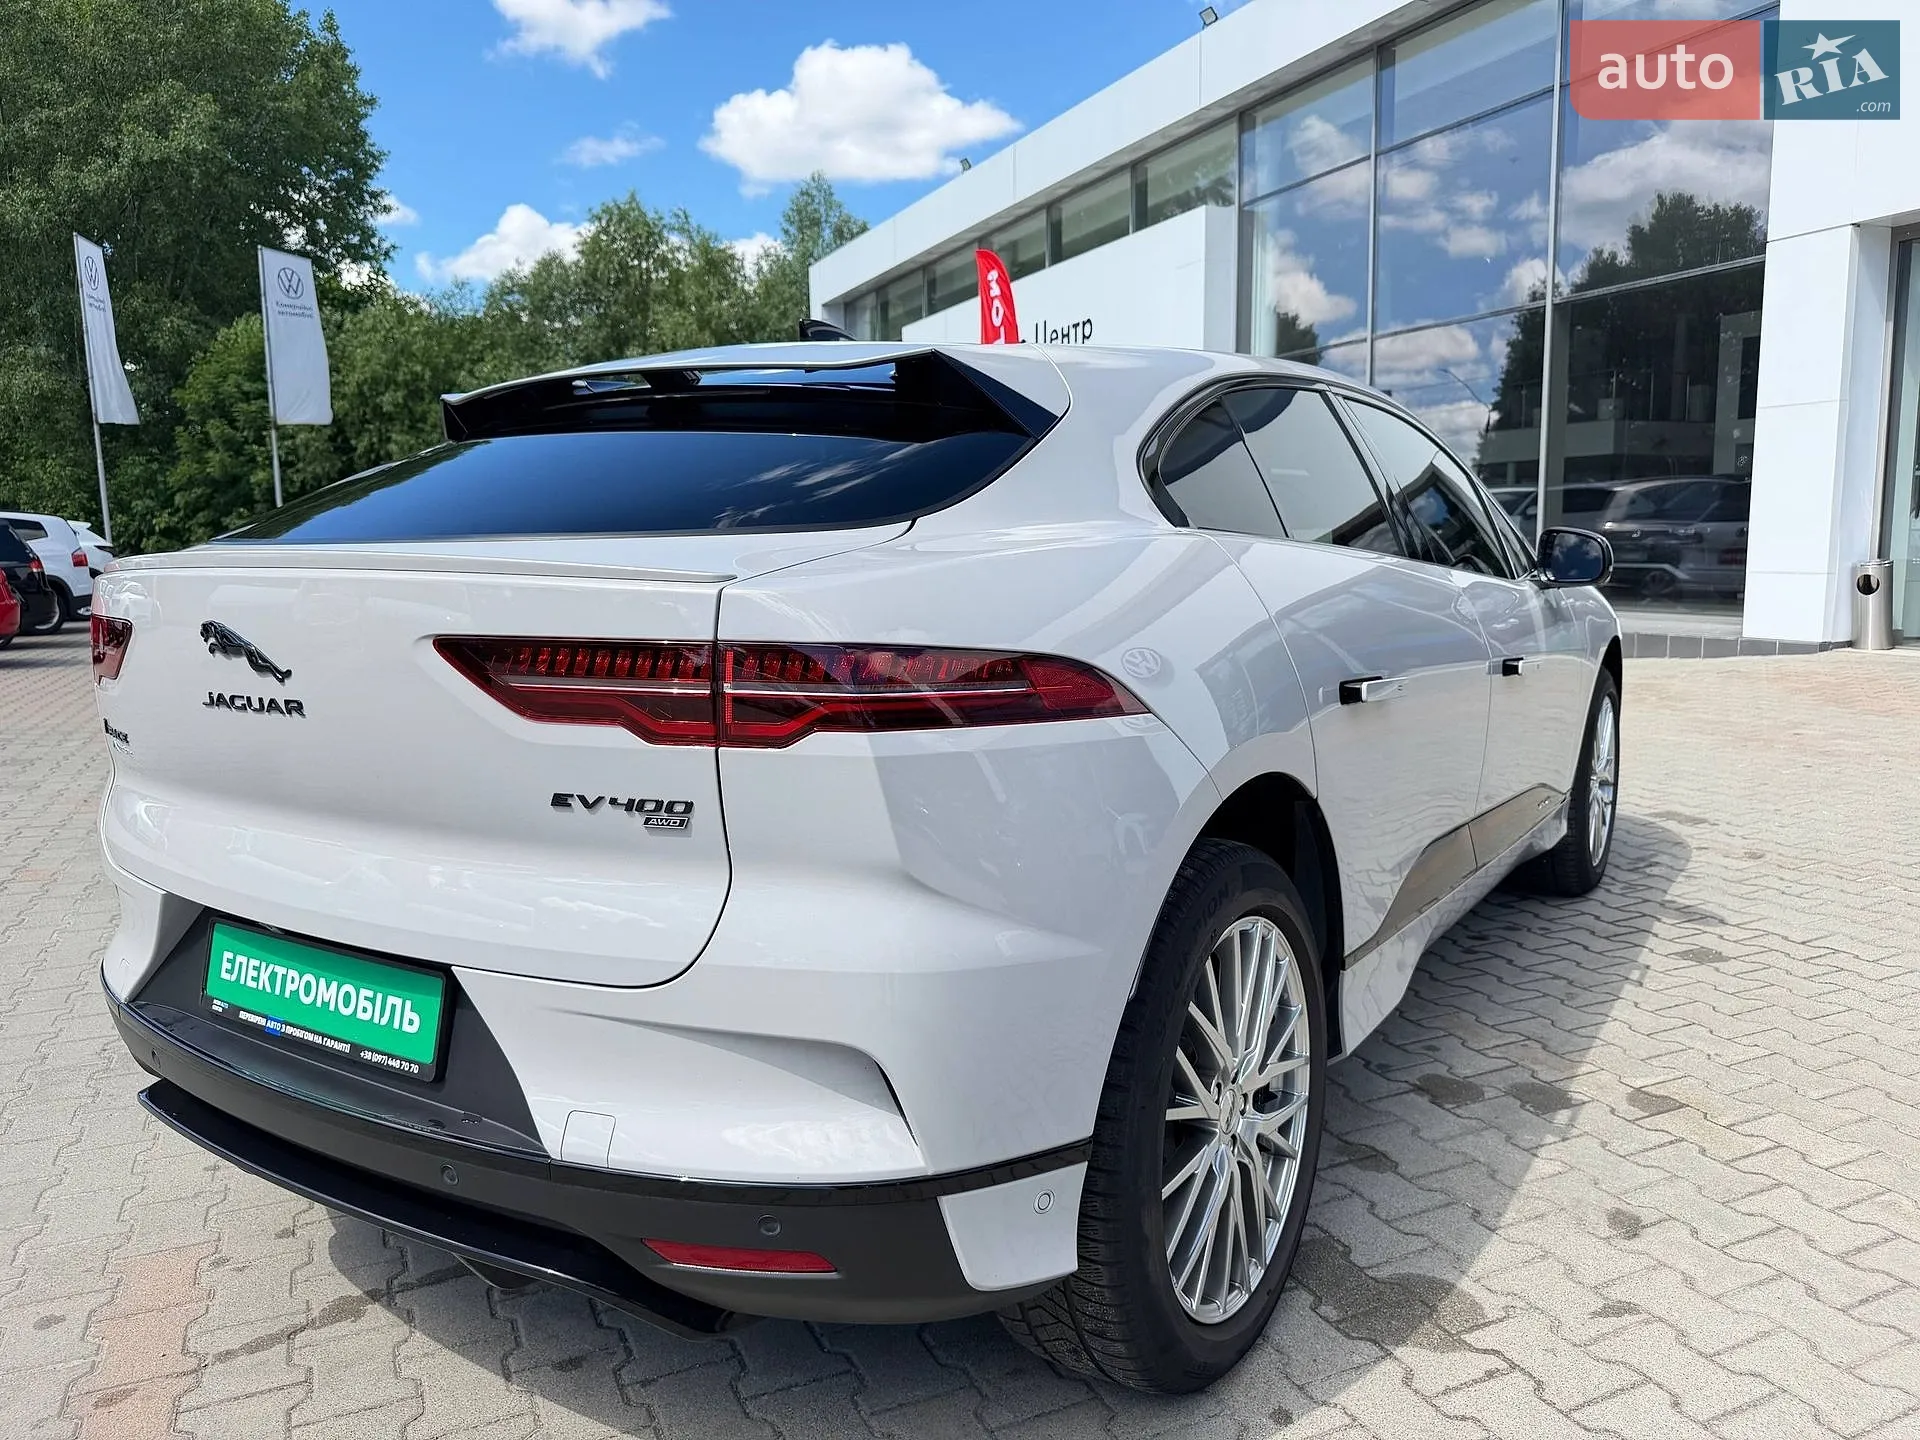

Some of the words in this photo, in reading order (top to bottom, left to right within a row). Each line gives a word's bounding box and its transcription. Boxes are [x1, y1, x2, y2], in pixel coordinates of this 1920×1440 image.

[202, 691, 306, 718] JAGUAR
[550, 792, 695, 815] EV400
[646, 817, 682, 828] AWD
[219, 950, 421, 1034] ЕЛЕКТРОМОБІЛЬ
[266, 1019, 281, 1031] АВТО
[359, 1050, 372, 1060] +38
[372, 1052, 388, 1066] (097)
[400, 1060, 410, 1071] 70
[410, 1063, 420, 1074] 70
